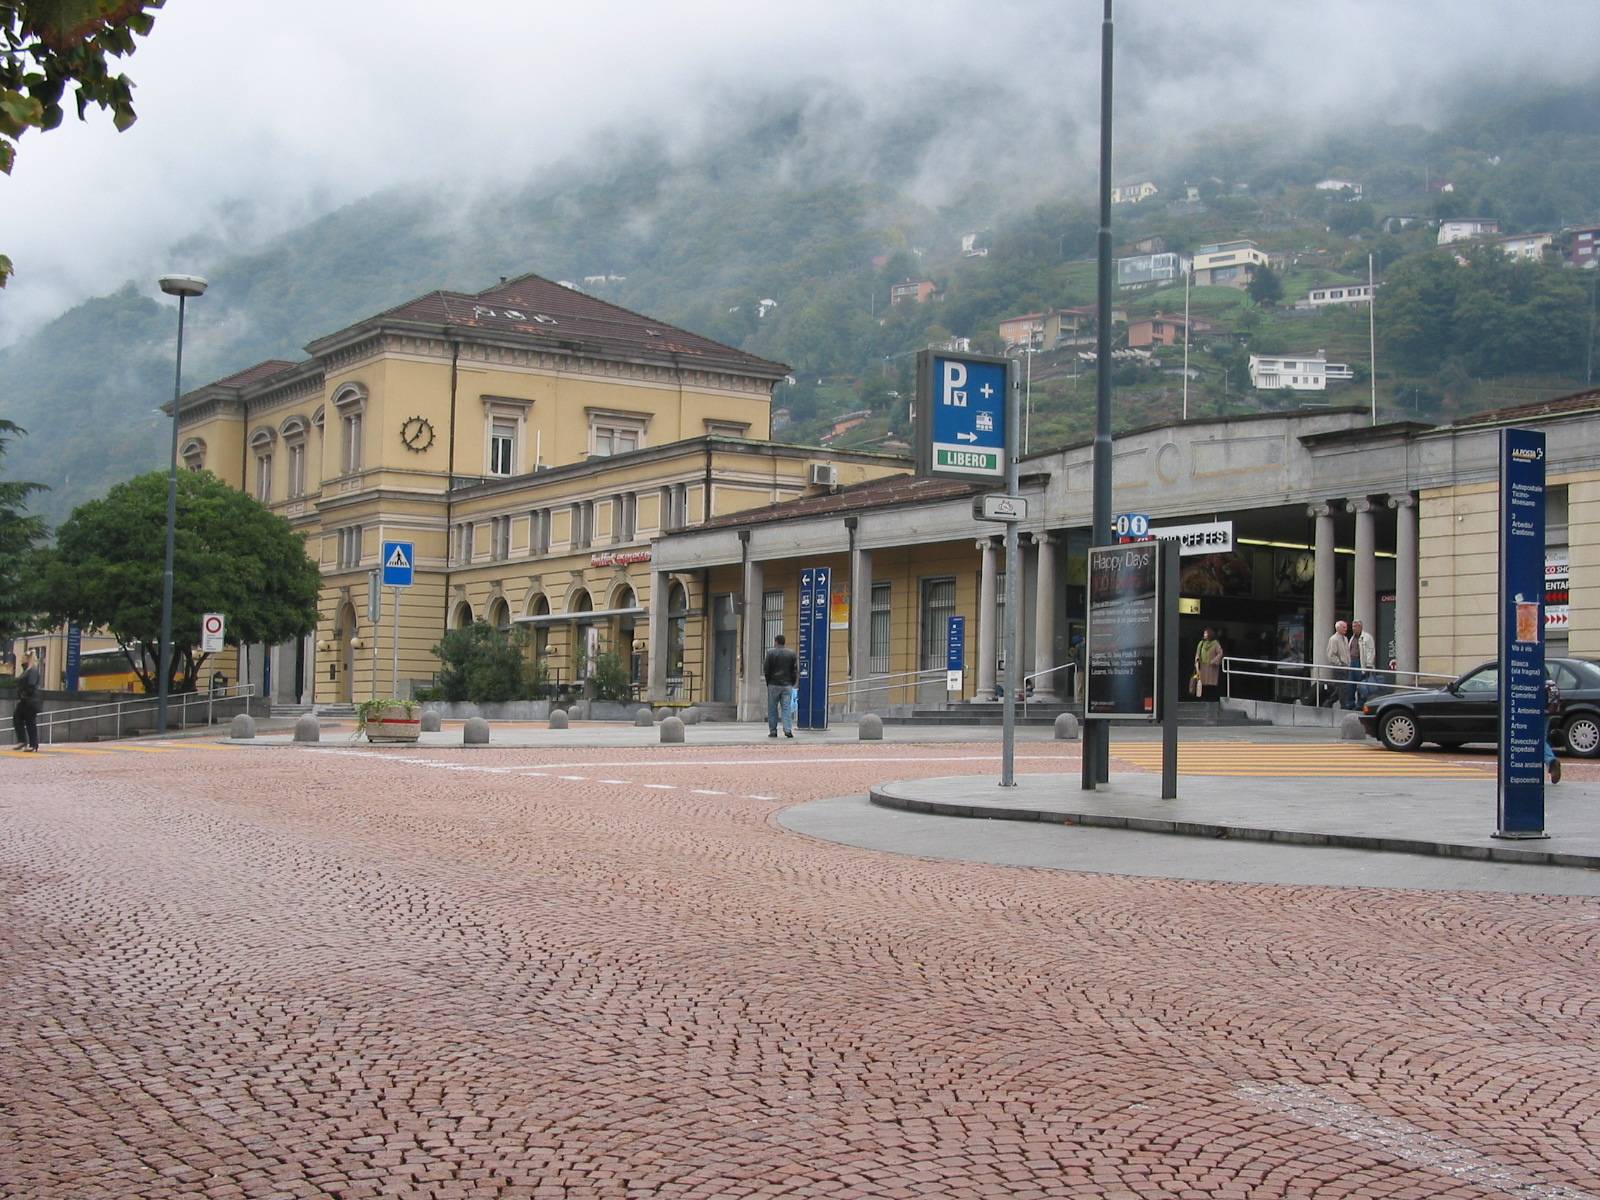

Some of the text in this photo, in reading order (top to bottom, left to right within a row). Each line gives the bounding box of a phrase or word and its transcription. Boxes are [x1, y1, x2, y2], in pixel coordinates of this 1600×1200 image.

[947, 451, 987, 468] LIBERO
[1181, 534, 1201, 547] CFF
[1205, 532, 1226, 545] FFS
[1093, 551, 1149, 572] Happy Days
